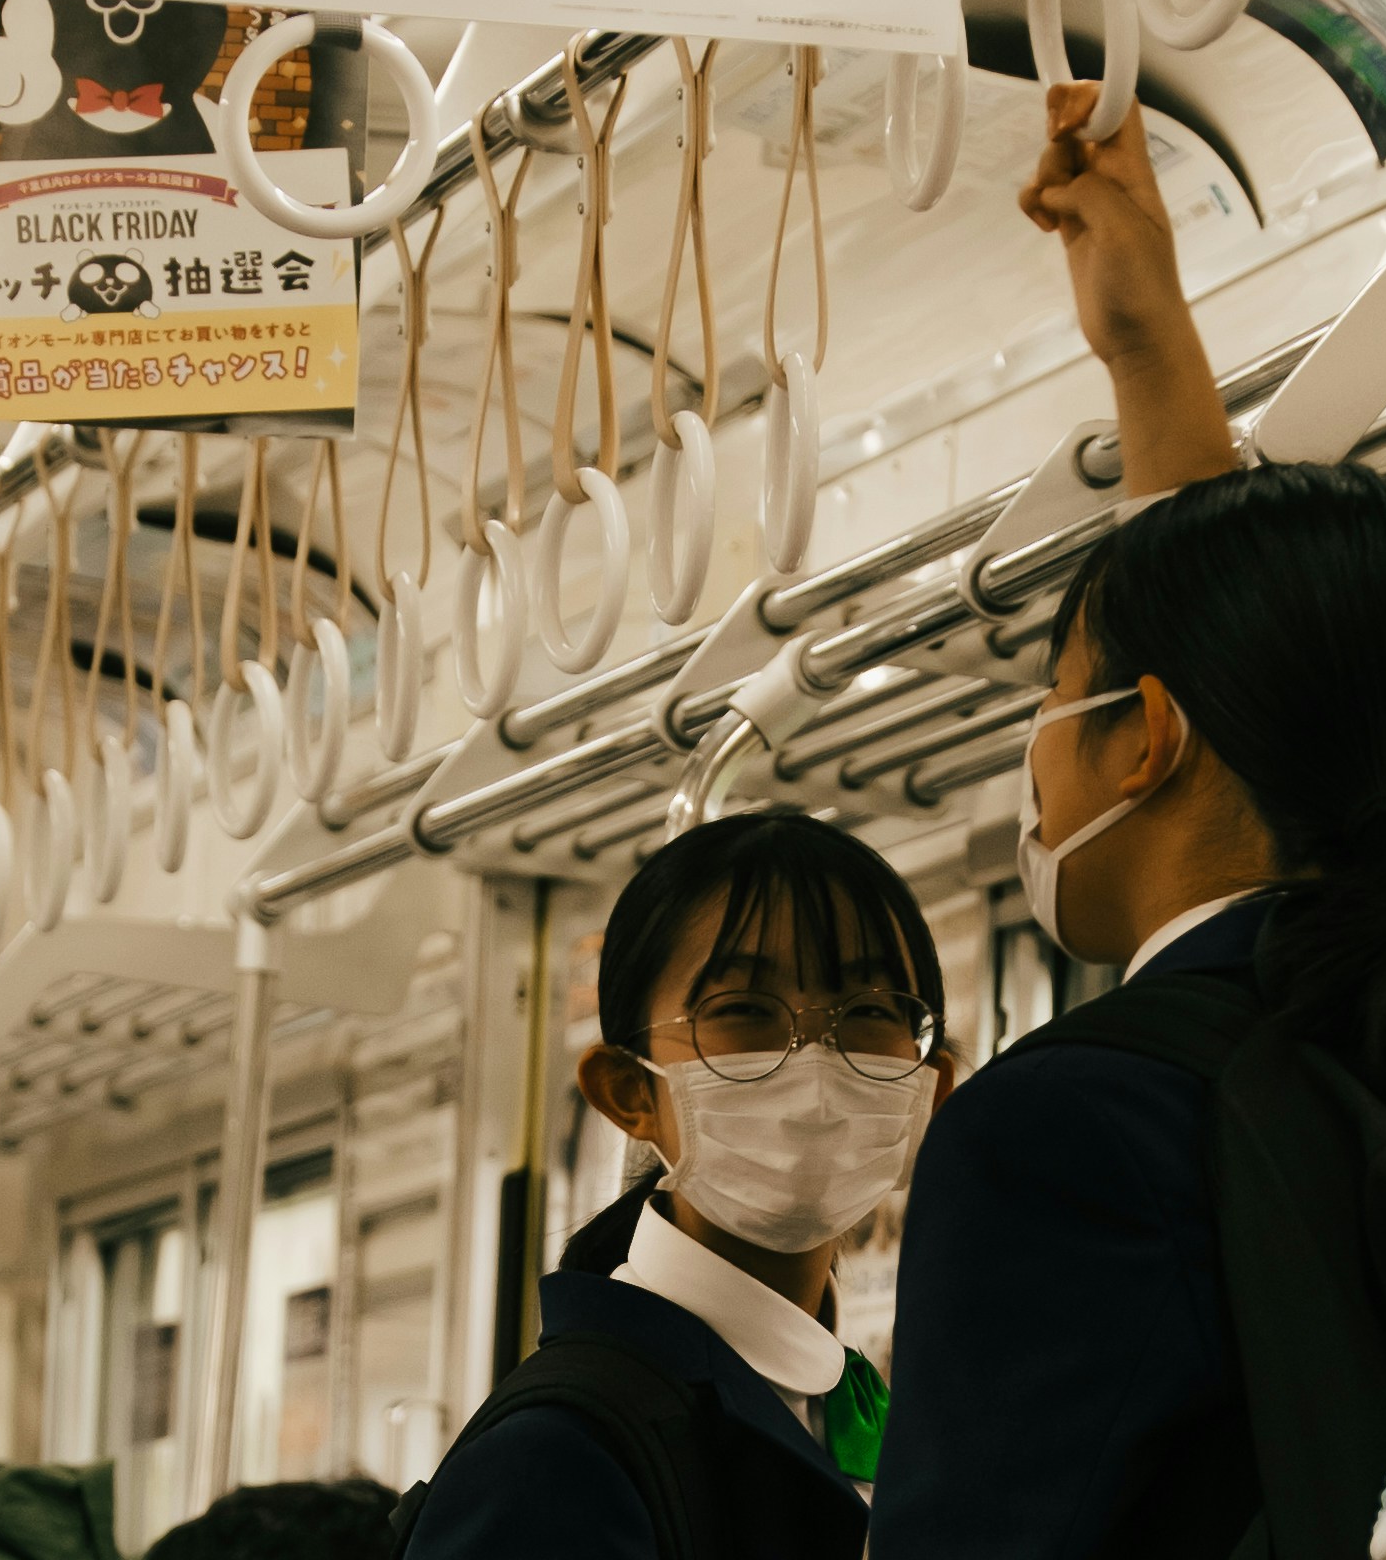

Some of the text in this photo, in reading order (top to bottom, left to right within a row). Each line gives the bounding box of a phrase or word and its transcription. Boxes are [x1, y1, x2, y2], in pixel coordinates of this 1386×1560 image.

[16, 208, 199, 244] BLACK FRIDAY
[163, 250, 316, 299] 抽選会
